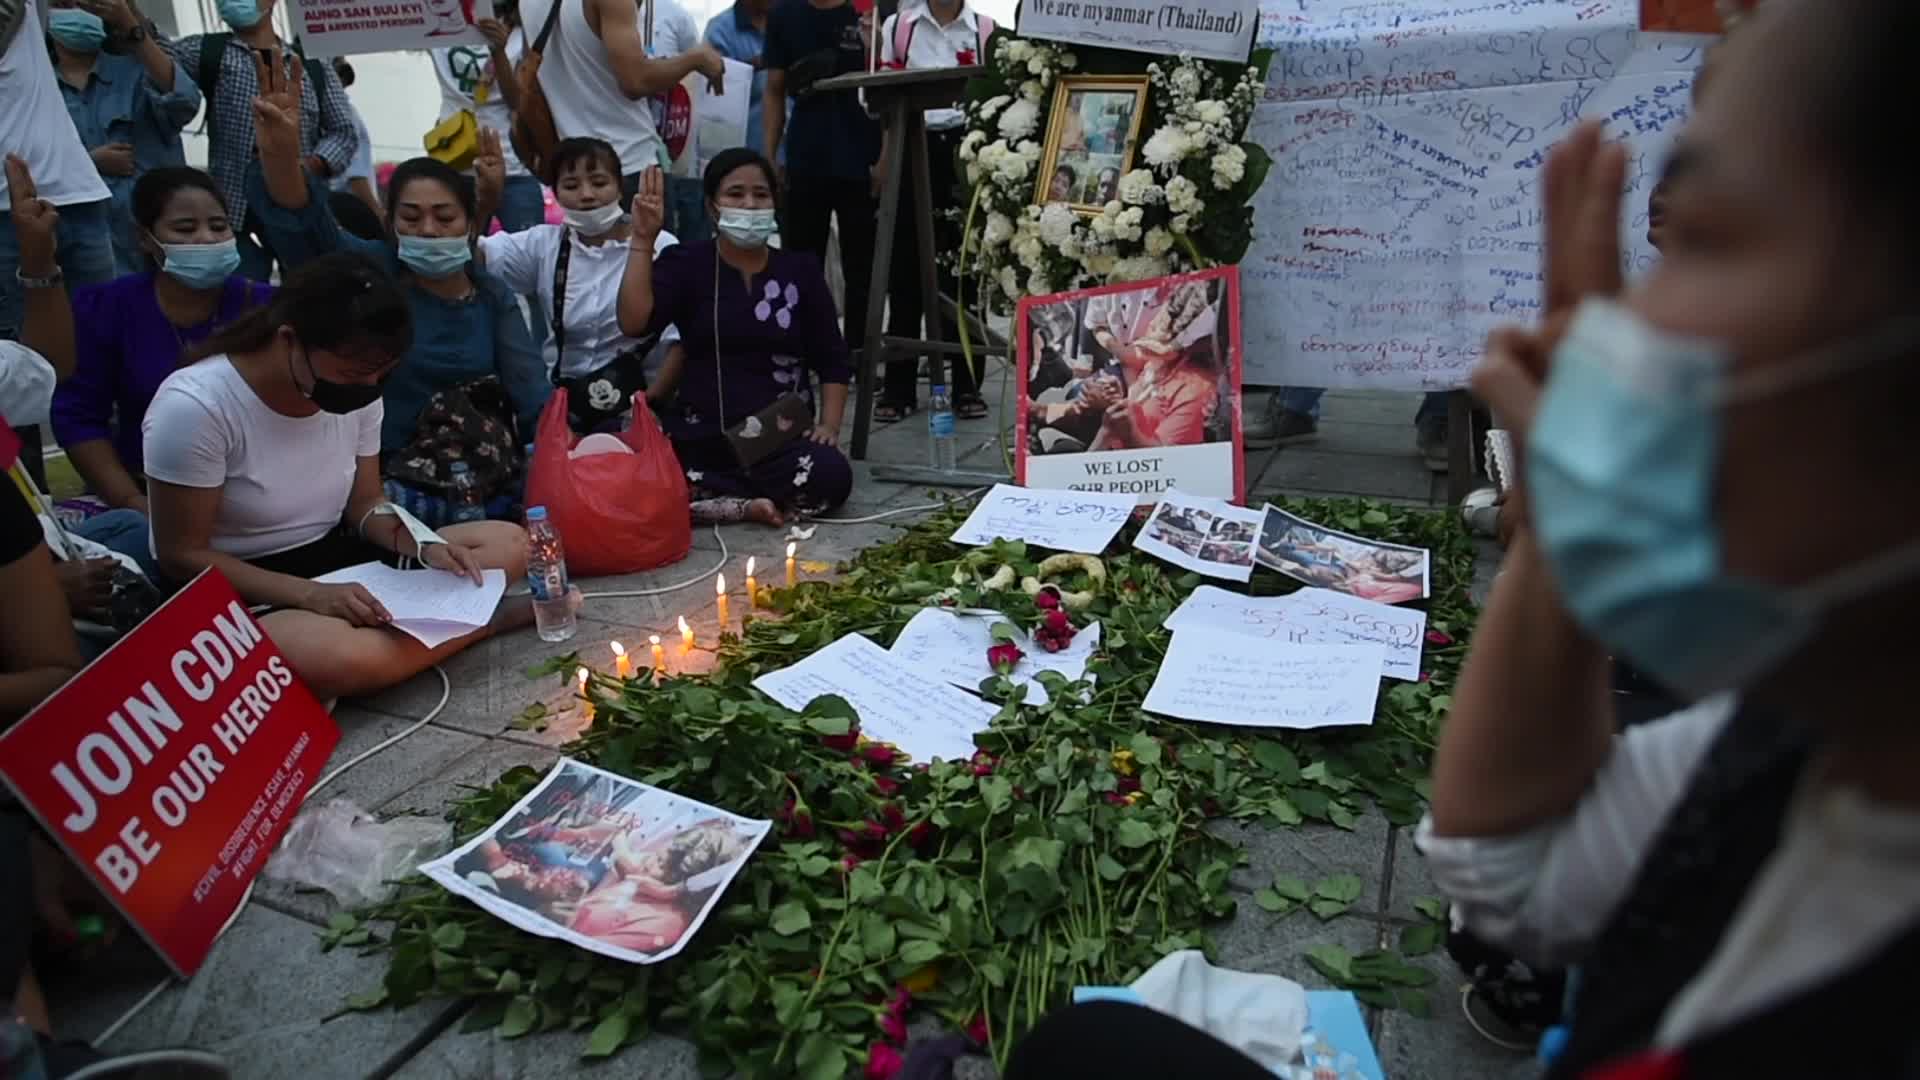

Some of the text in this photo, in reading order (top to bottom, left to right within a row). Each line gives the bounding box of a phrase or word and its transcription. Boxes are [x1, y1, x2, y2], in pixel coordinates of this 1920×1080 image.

[343, 7, 371, 18] SAN
[1033, 0, 1243, 37] We are myanmar (Thailand)
[1085, 458, 1163, 476] WE LOST
[1109, 478, 1177, 494] PEOPLE
[50, 600, 263, 833] JOIN CDM
[95, 655, 293, 894] BE OUR HEROS
